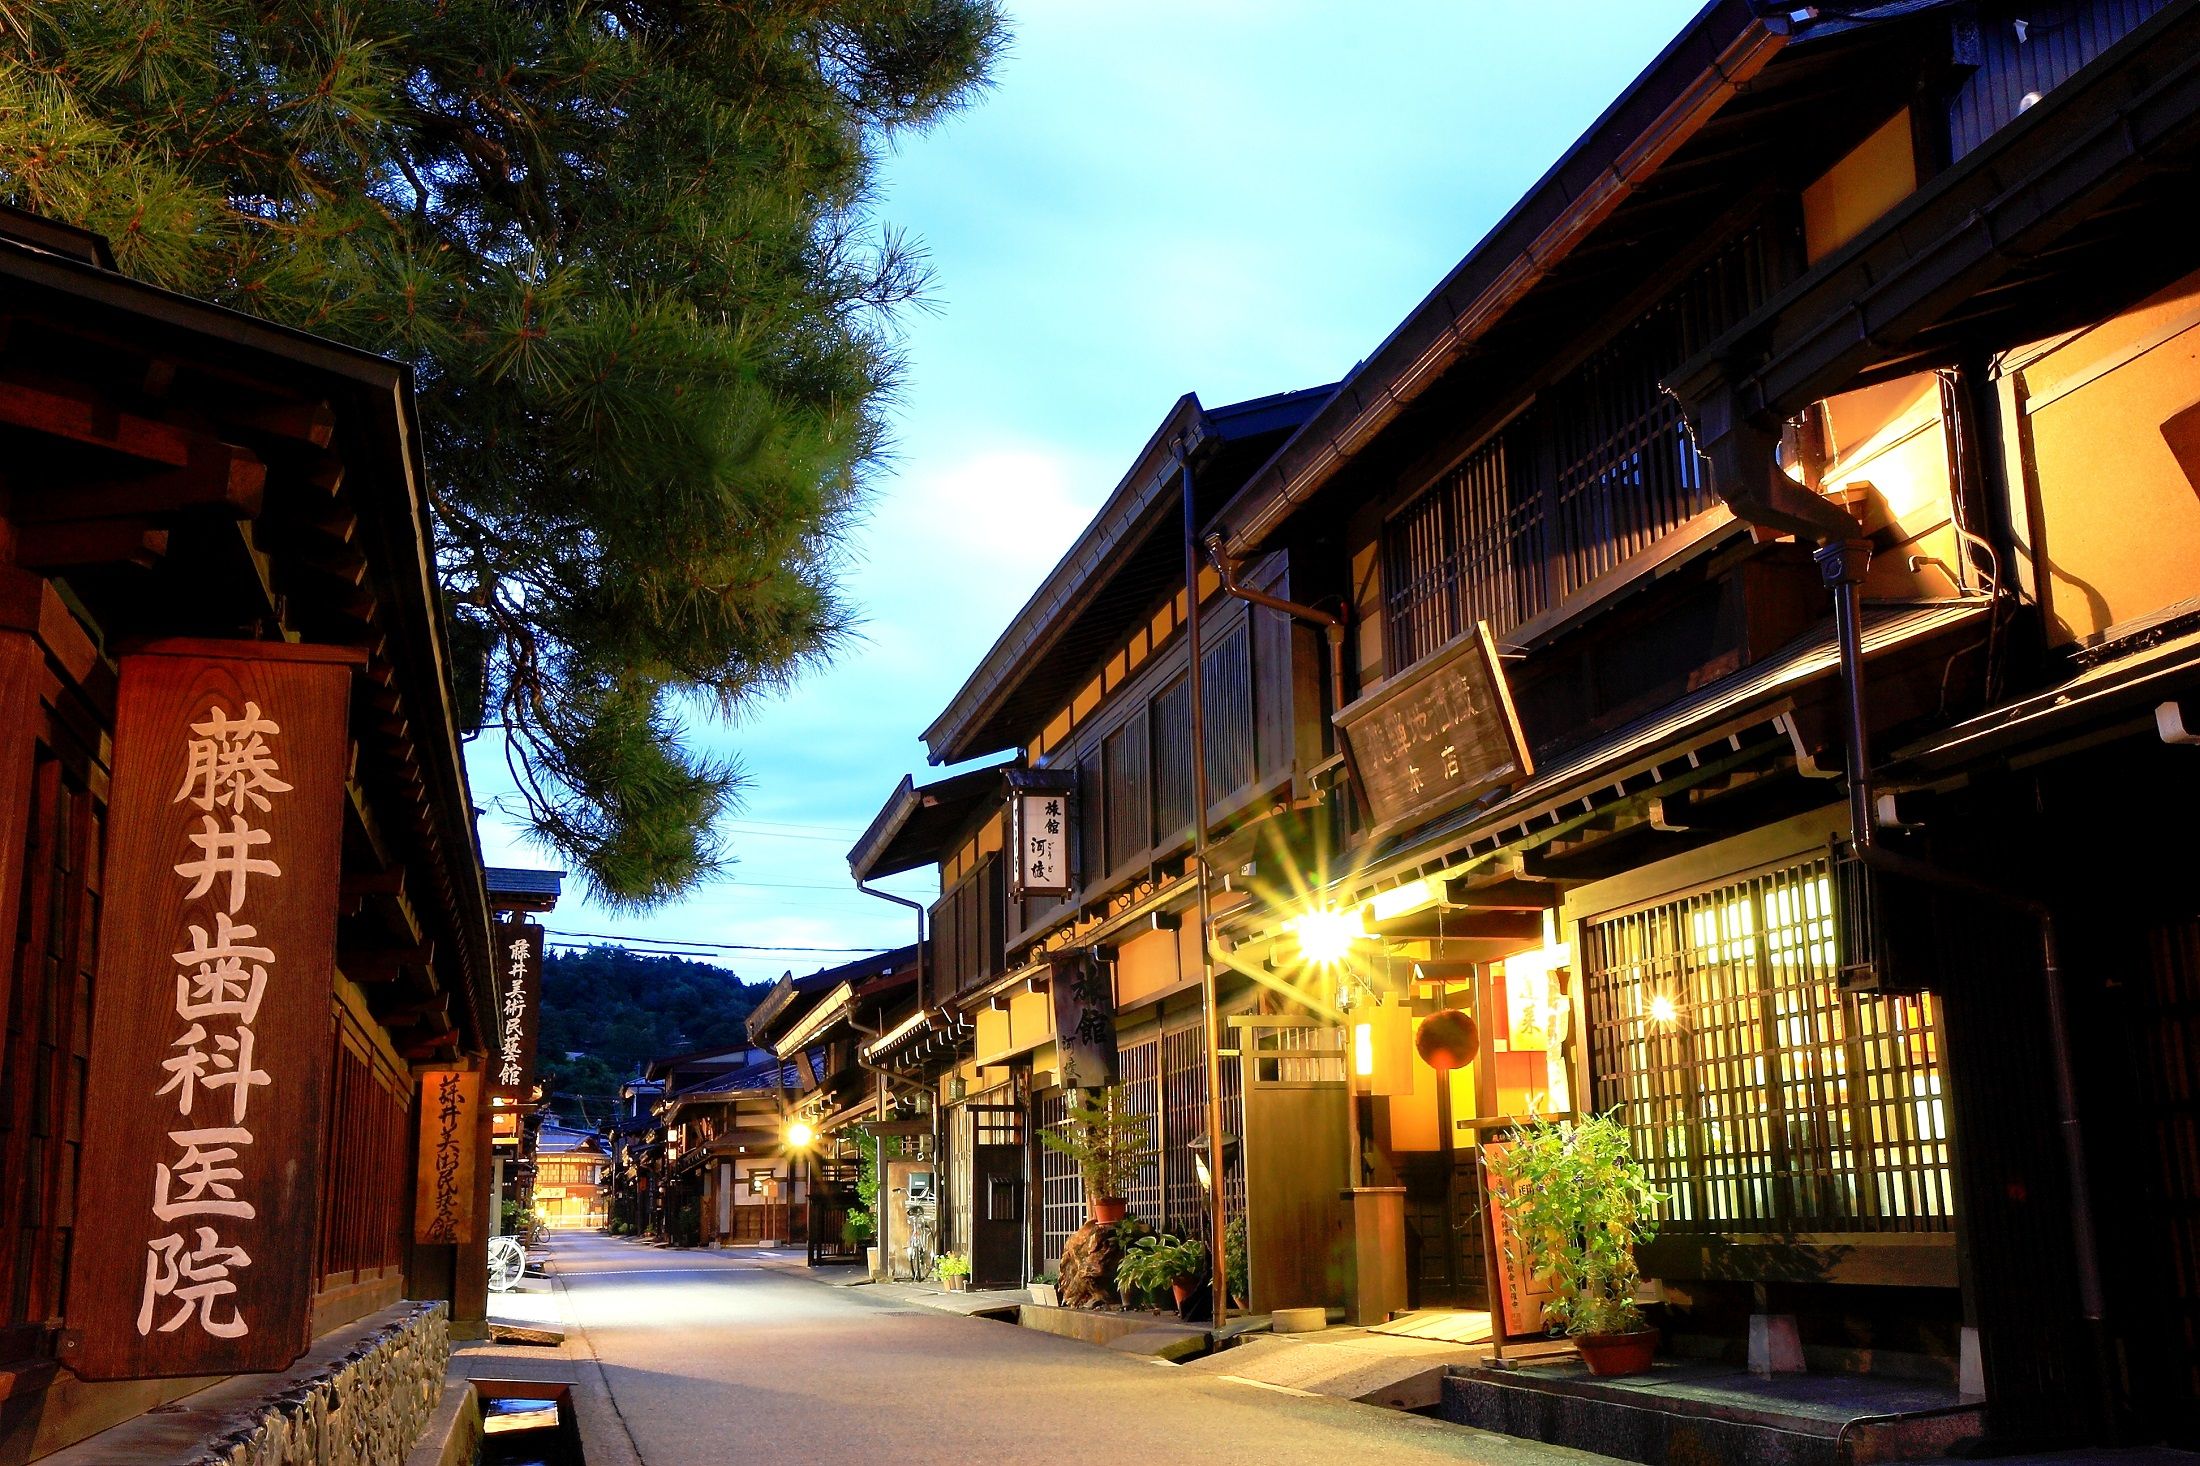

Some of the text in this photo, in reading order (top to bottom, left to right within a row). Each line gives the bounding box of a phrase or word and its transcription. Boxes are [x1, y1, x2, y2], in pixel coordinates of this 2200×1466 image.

[1044, 799, 1061, 834] 旅館
[1407, 745, 1459, 794] 本店
[137, 701, 294, 1338] 藤井歯科医院
[498, 938, 531, 1086] 藤井美術民藝館
